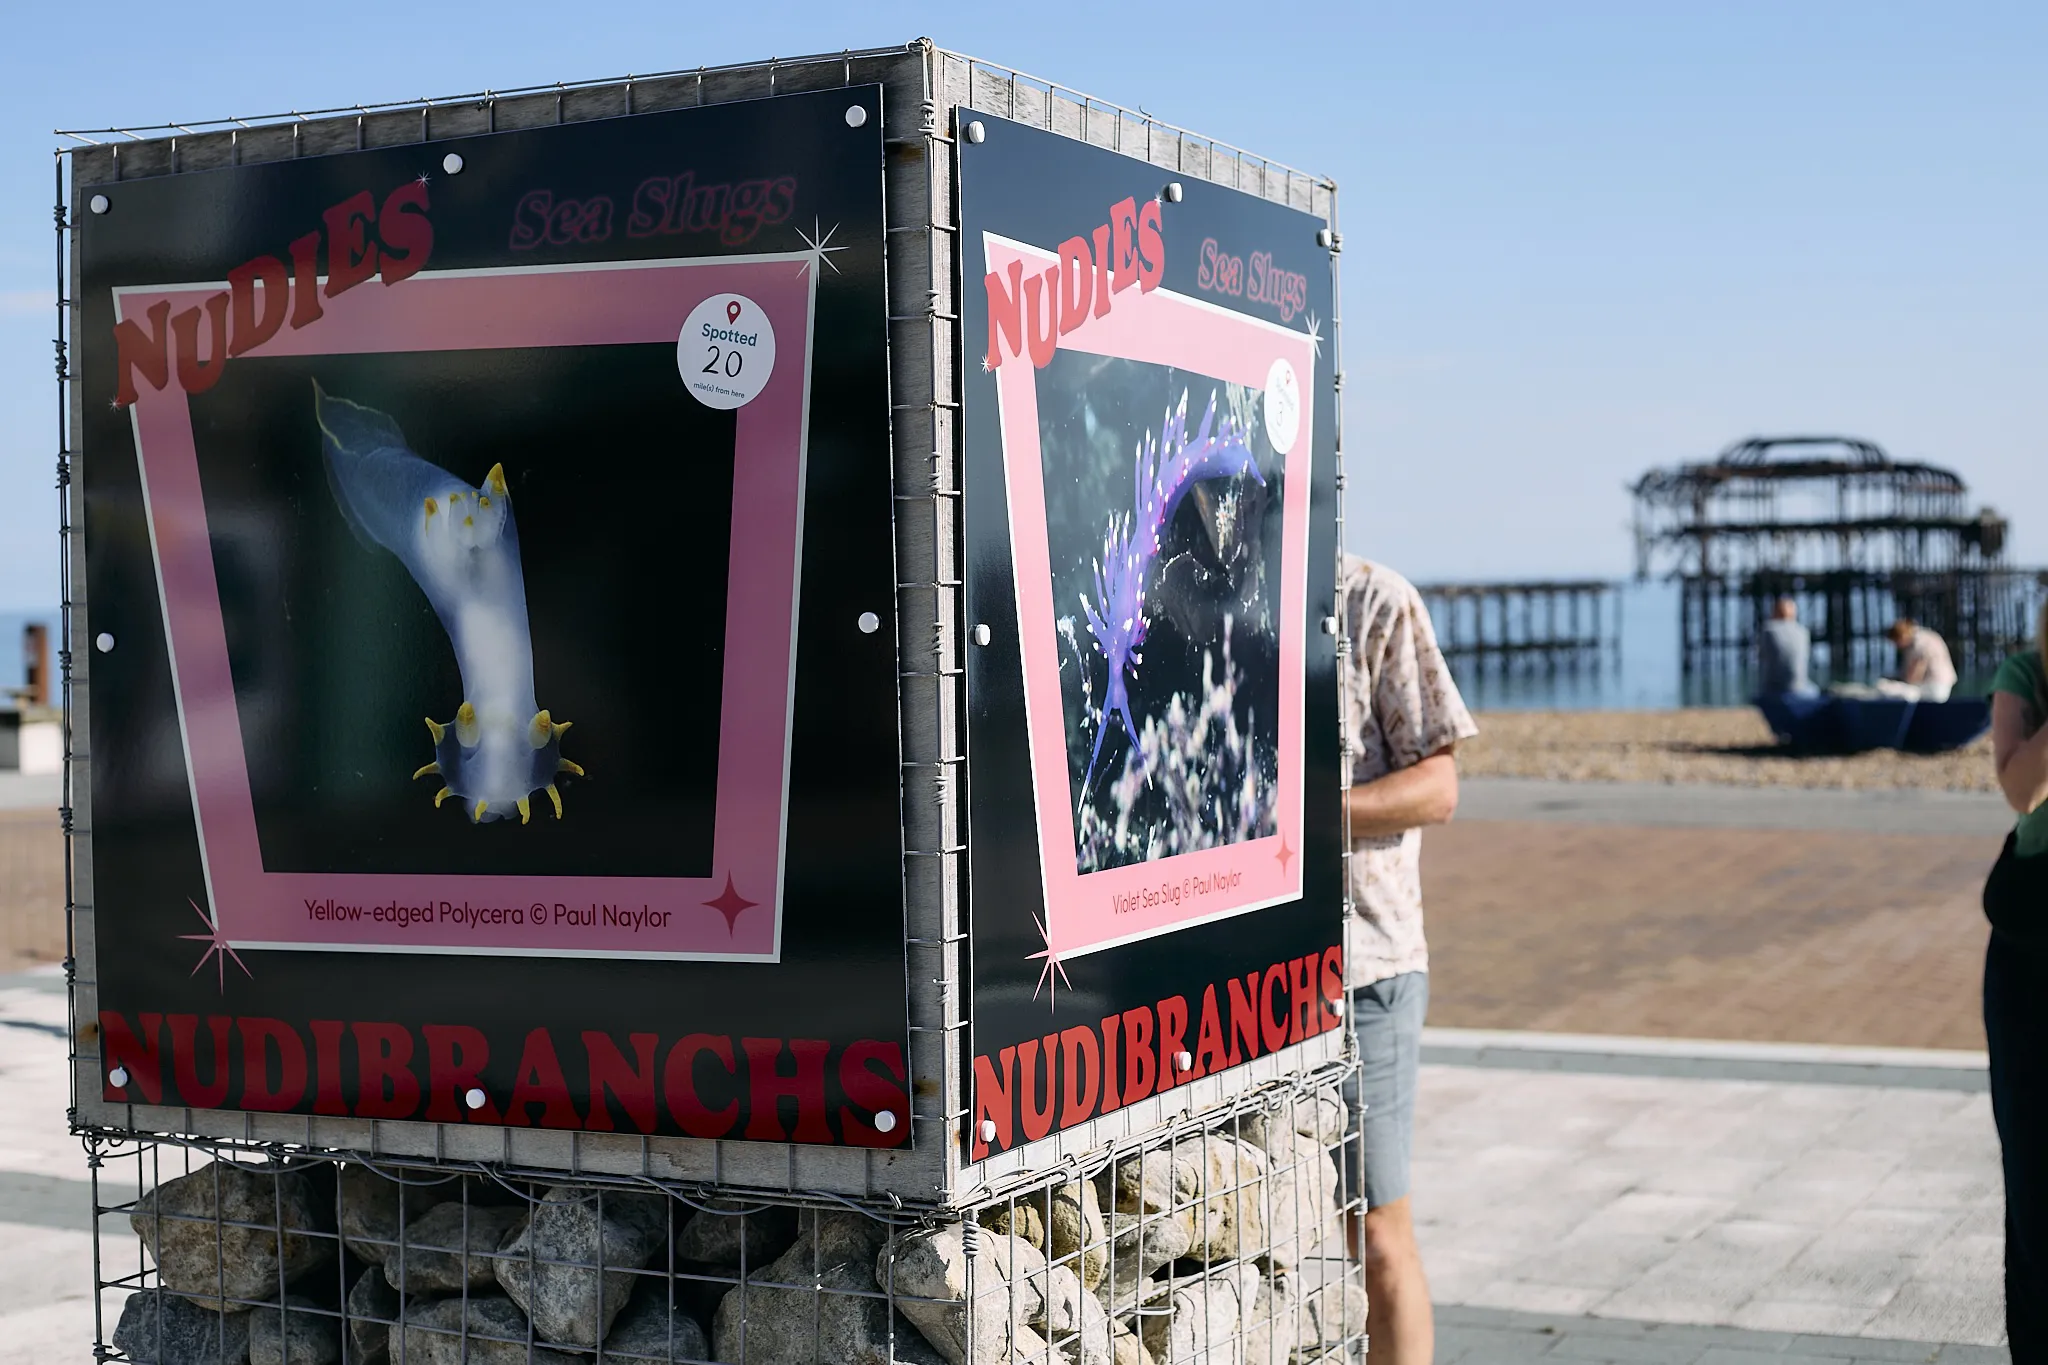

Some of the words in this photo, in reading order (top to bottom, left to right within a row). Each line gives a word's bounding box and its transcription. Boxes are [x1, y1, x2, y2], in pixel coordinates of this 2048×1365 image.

[509, 189, 613, 249] Sea
[627, 170, 796, 245] Slugs
[113, 181, 434, 408] NUDIES
[984, 196, 1165, 372] NUDIES
[1198, 237, 1243, 296] Sea
[1247, 250, 1306, 322] Slugs
[701, 323, 758, 347] Spotted
[702, 345, 743, 378] 20
[693, 382, 715, 392] mile(s)
[715, 386, 730, 396] from
[731, 390, 745, 398] here
[304, 899, 434, 928] Yellow-edged
[439, 902, 524, 929] Polycera
[554, 904, 597, 926] Paul
[602, 905, 672, 933] Naylor
[1112, 890, 1141, 915] Violet
[1142, 888, 1160, 908] Sea
[1161, 882, 1181, 906] Slug
[1193, 873, 1212, 898] Paul
[1213, 868, 1242, 894] Naylor
[99, 1010, 911, 1149] NUDIBRANCHS
[972, 944, 1343, 1162] NUDIBRANCHS
